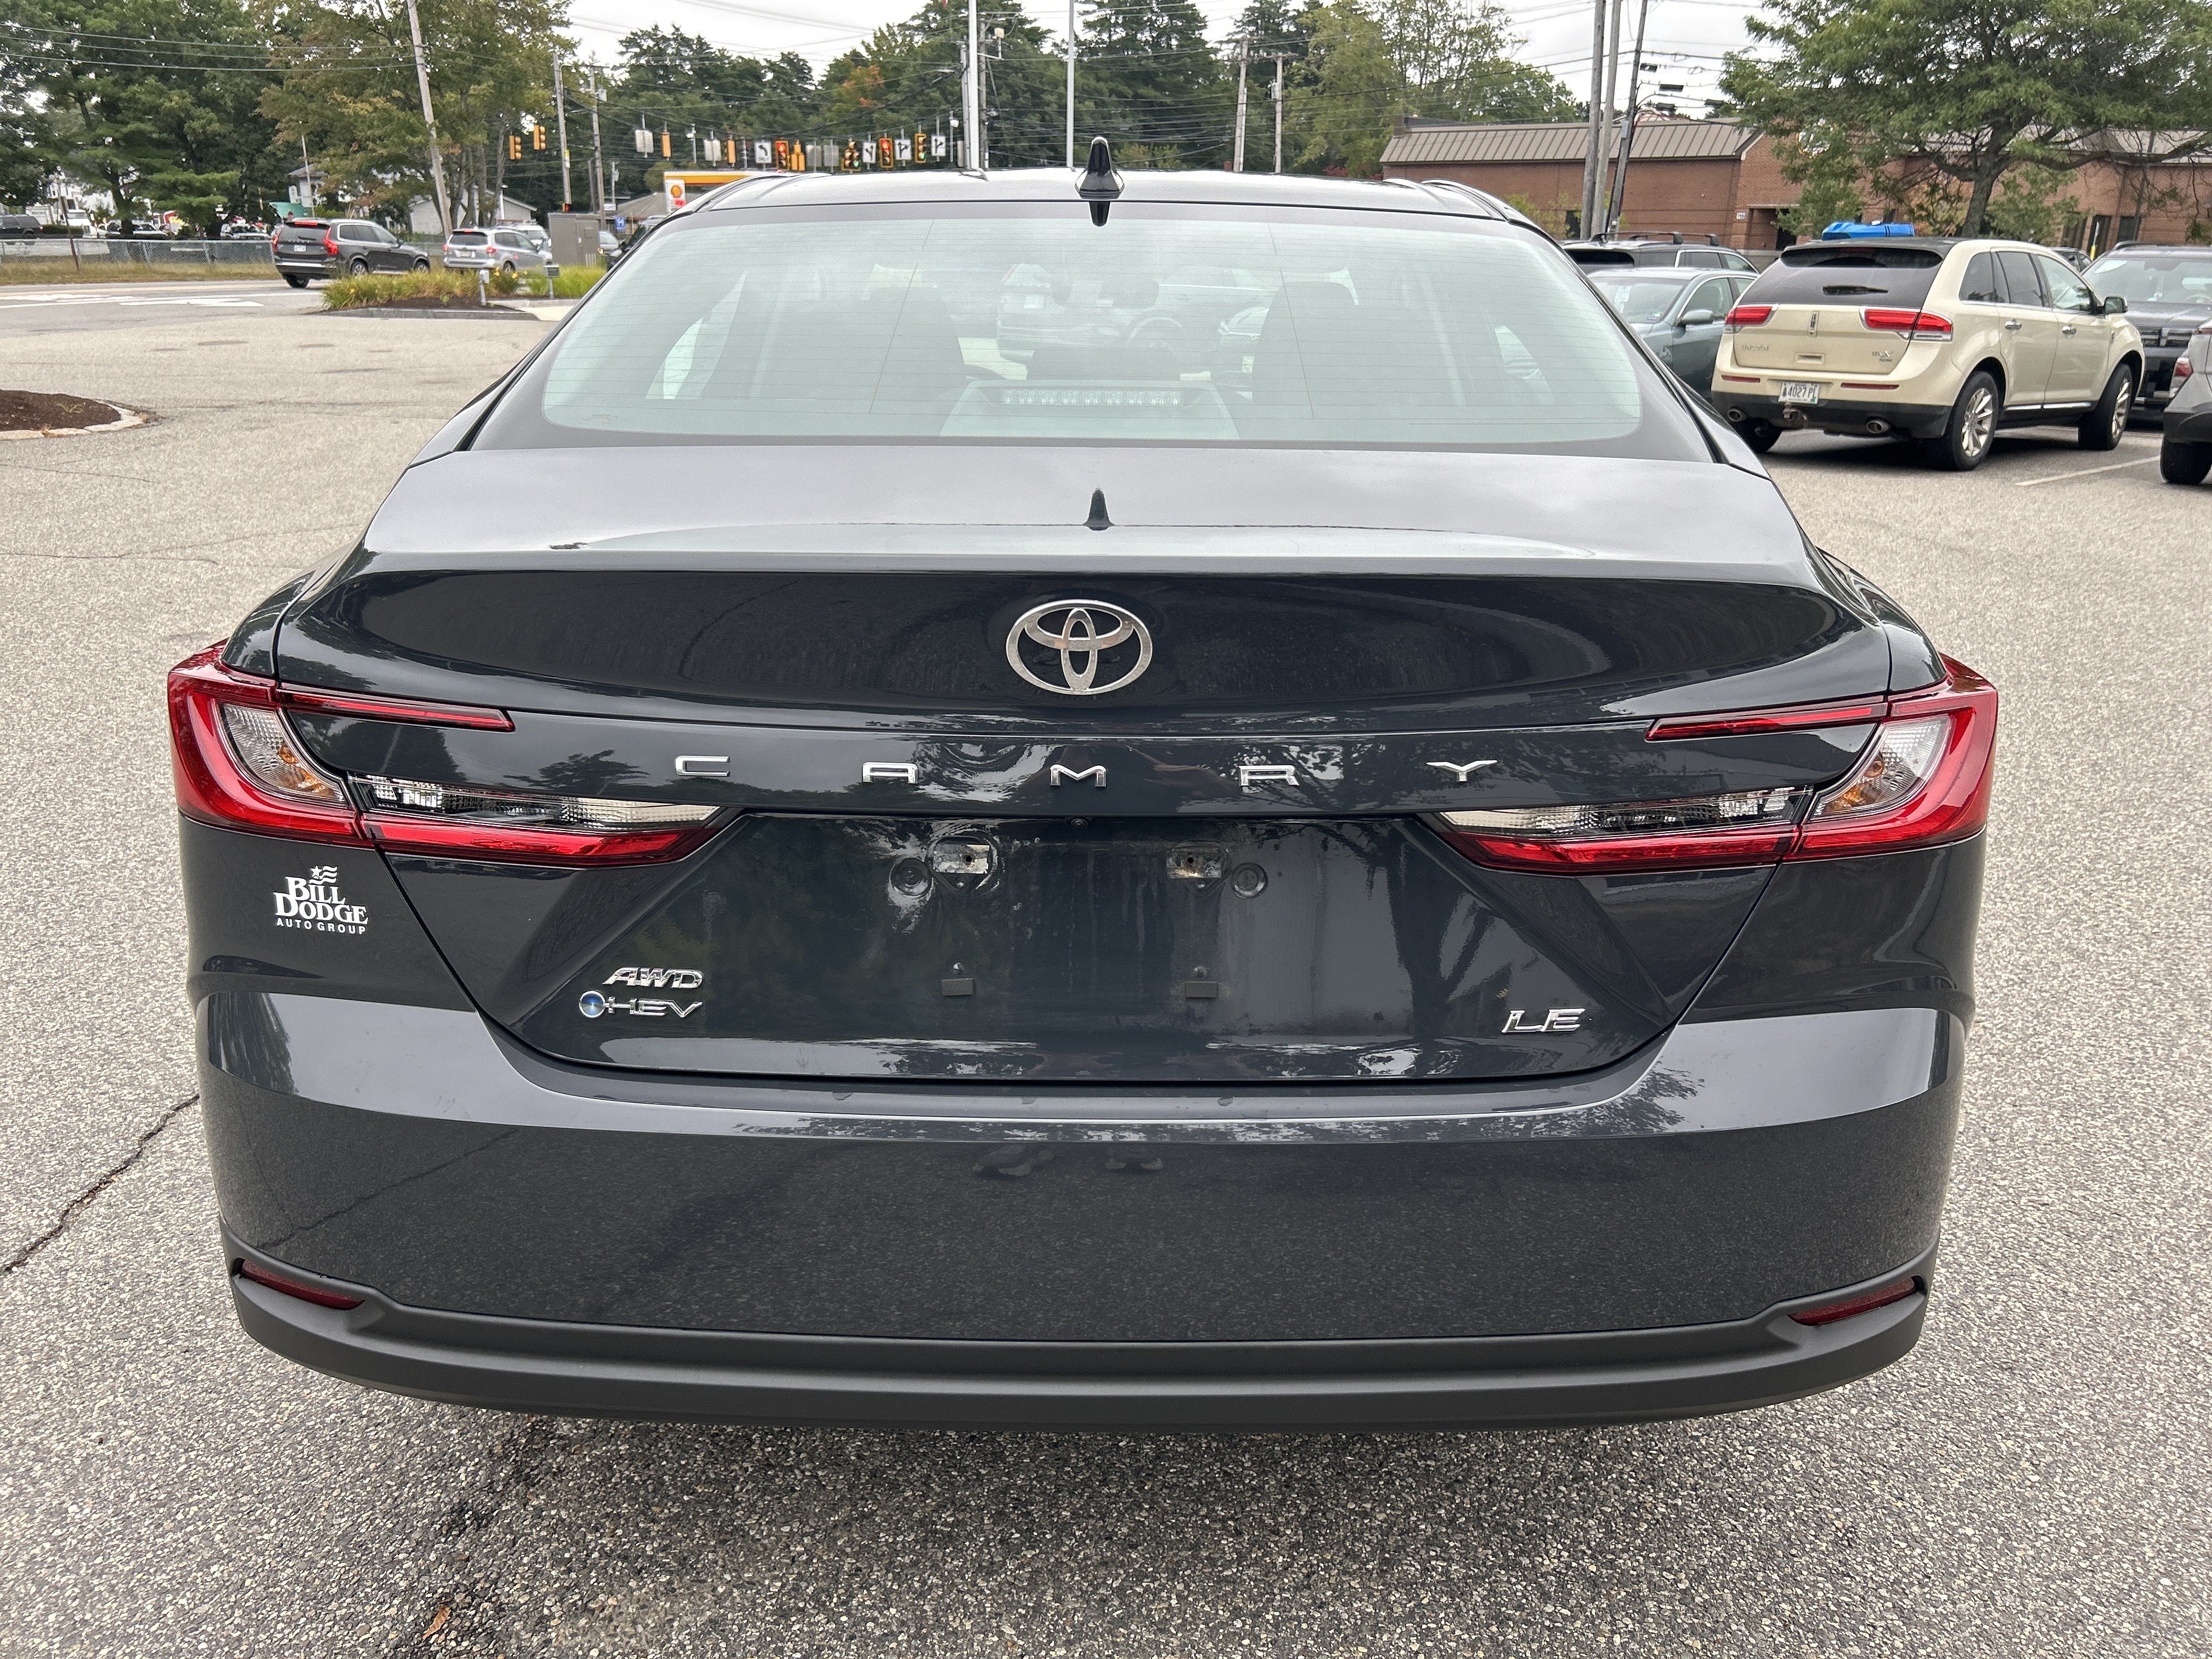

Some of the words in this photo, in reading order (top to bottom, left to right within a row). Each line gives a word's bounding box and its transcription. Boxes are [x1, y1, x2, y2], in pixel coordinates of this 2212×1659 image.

[675, 755, 1498, 787] CAMRY
[285, 876, 346, 905] BILL
[273, 892, 369, 924] DODGE
[276, 917, 312, 930] AUTO
[317, 922, 366, 935] GROUP
[602, 967, 703, 988] AWD
[604, 996, 703, 1018] HEV
[1501, 1008, 1586, 1033] LE
